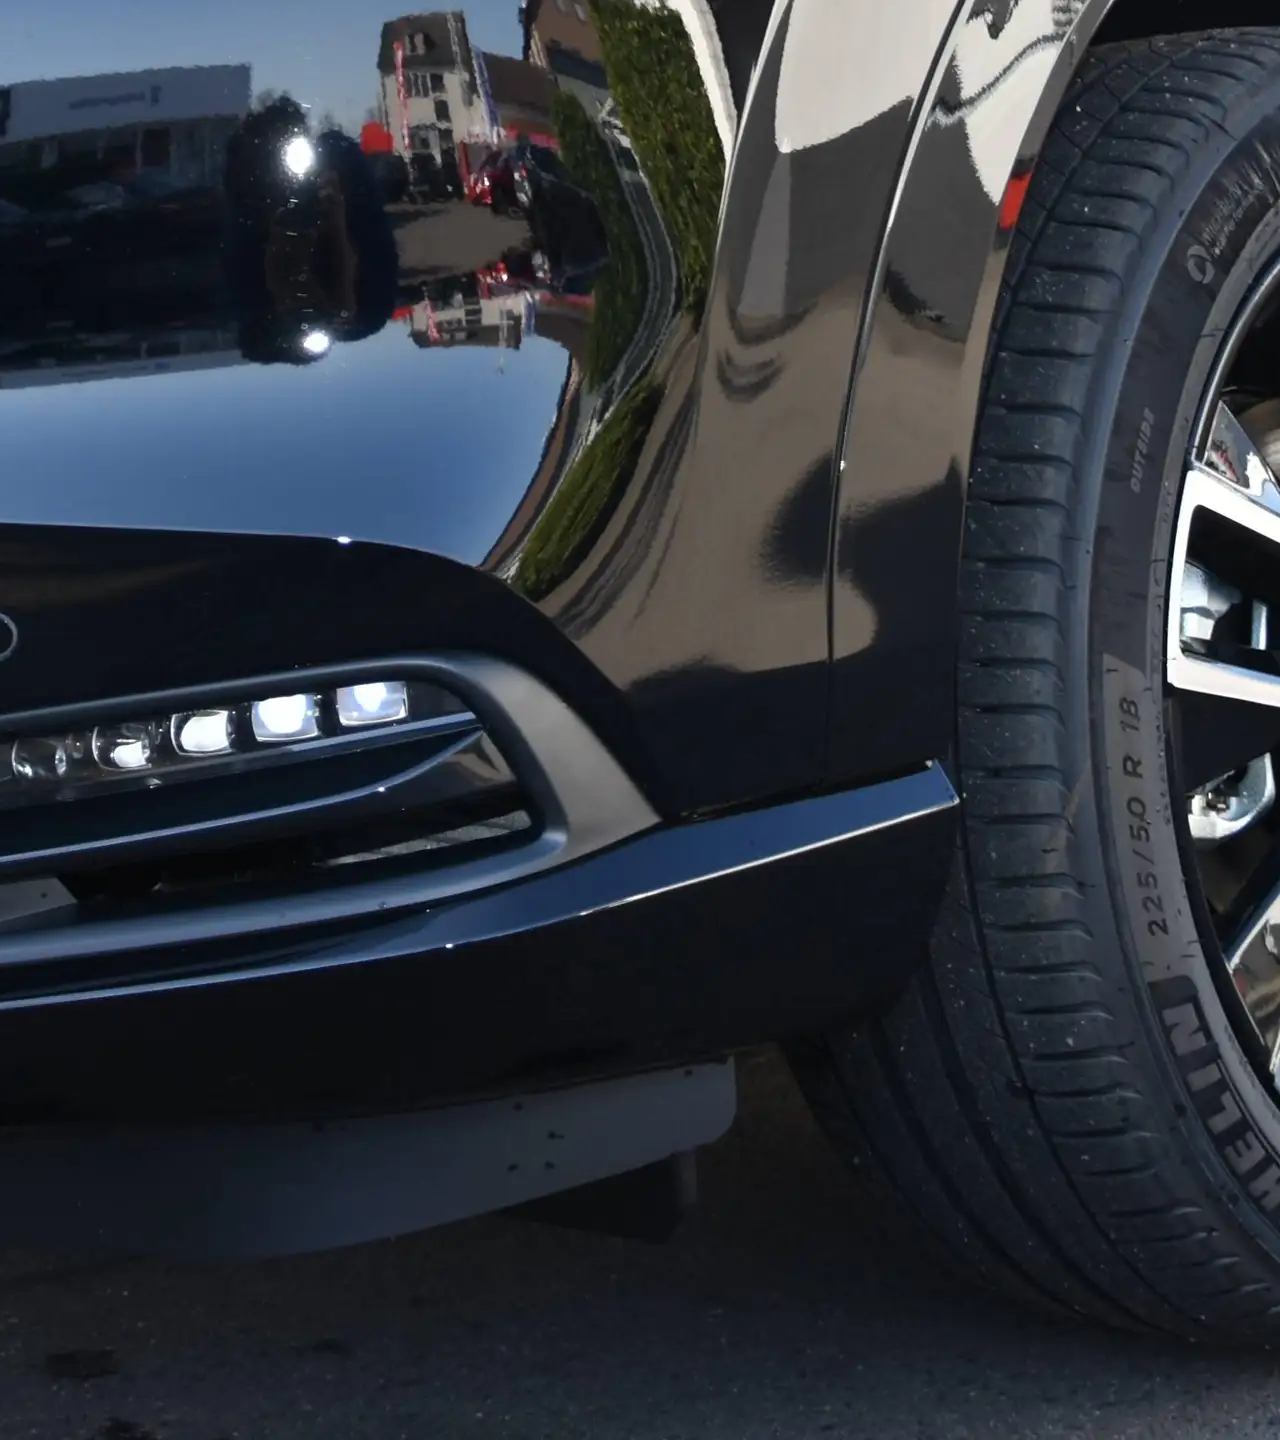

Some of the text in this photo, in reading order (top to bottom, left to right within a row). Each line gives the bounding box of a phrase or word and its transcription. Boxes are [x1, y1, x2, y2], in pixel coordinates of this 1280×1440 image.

[1119, 697, 1170, 936] 225/50 R 18
